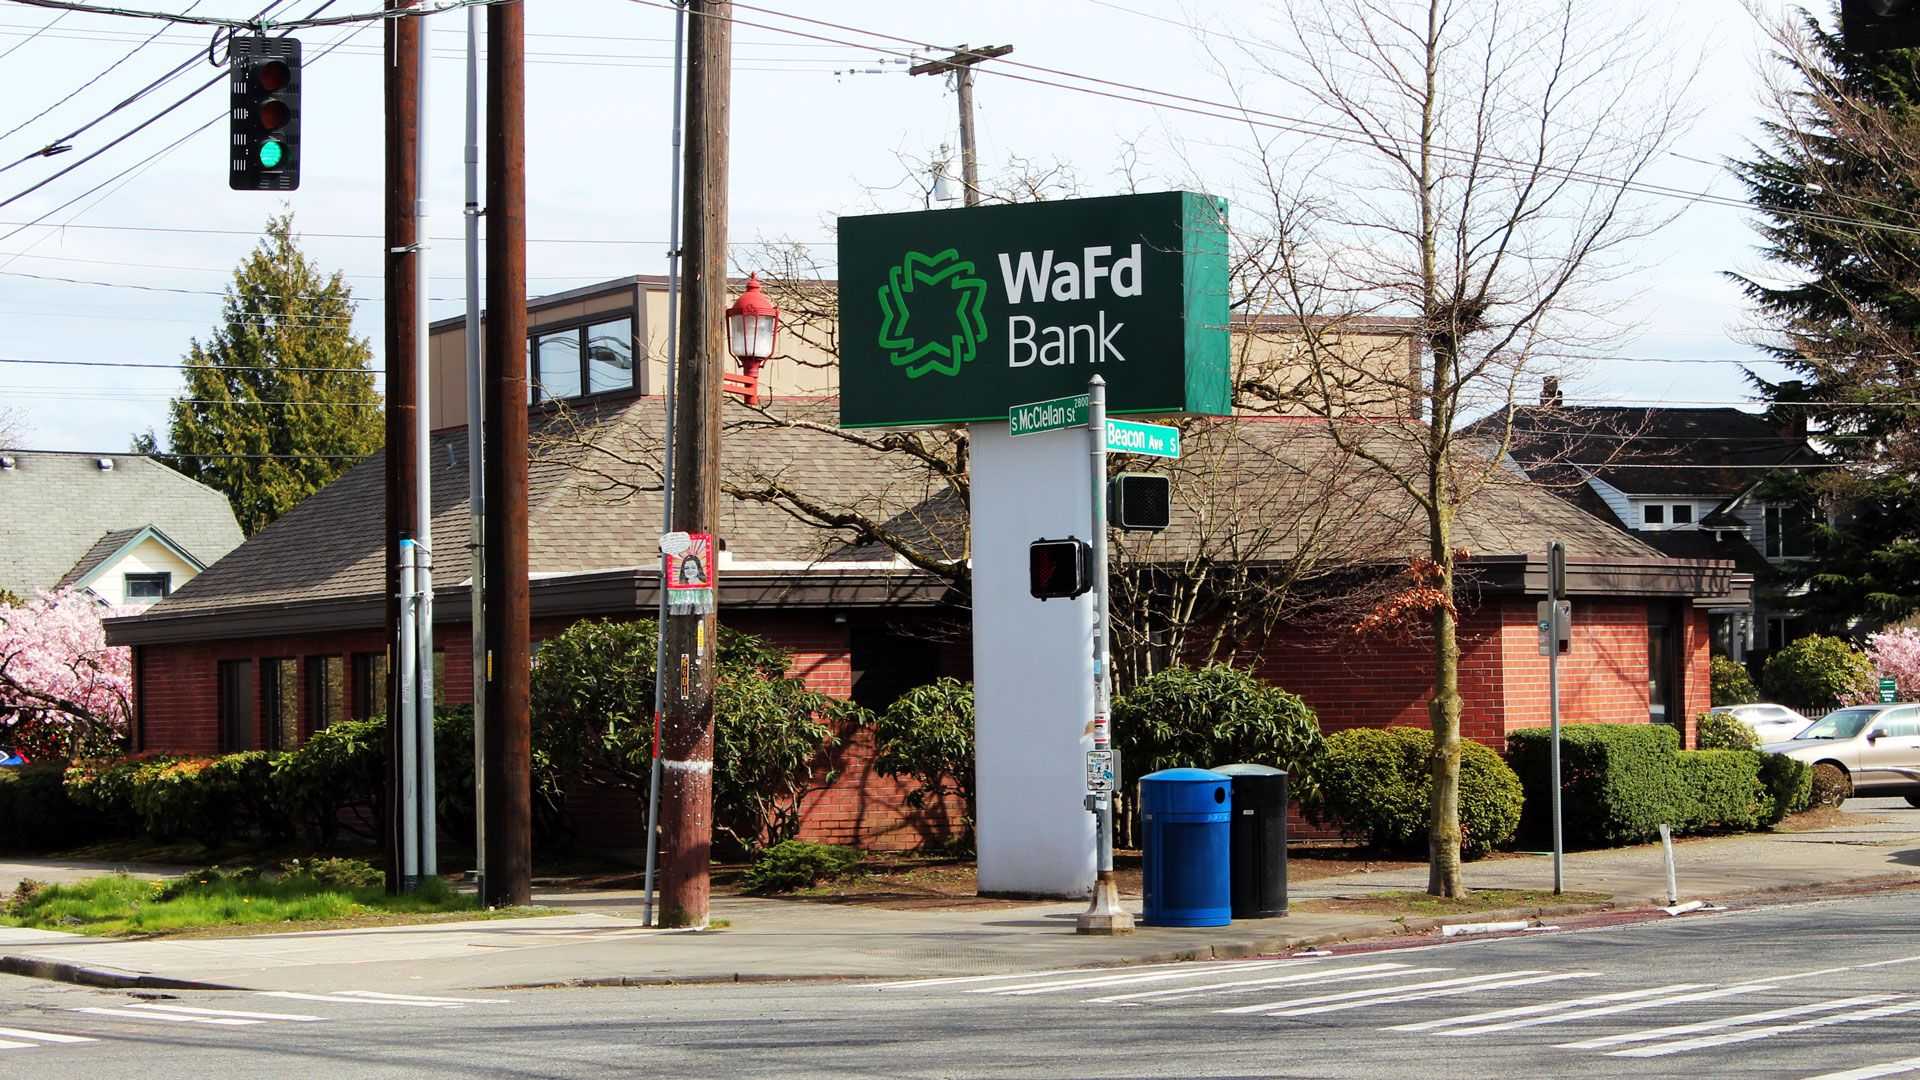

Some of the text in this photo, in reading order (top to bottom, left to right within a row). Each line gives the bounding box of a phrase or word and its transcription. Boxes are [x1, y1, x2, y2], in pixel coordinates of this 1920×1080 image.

[998, 243, 1142, 304] WaFd
[1008, 310, 1126, 368] Bank
[1074, 396, 1089, 409] 2800
[1011, 404, 1076, 432] S McClellan St
[1107, 423, 1177, 453] Beacon Ave S
